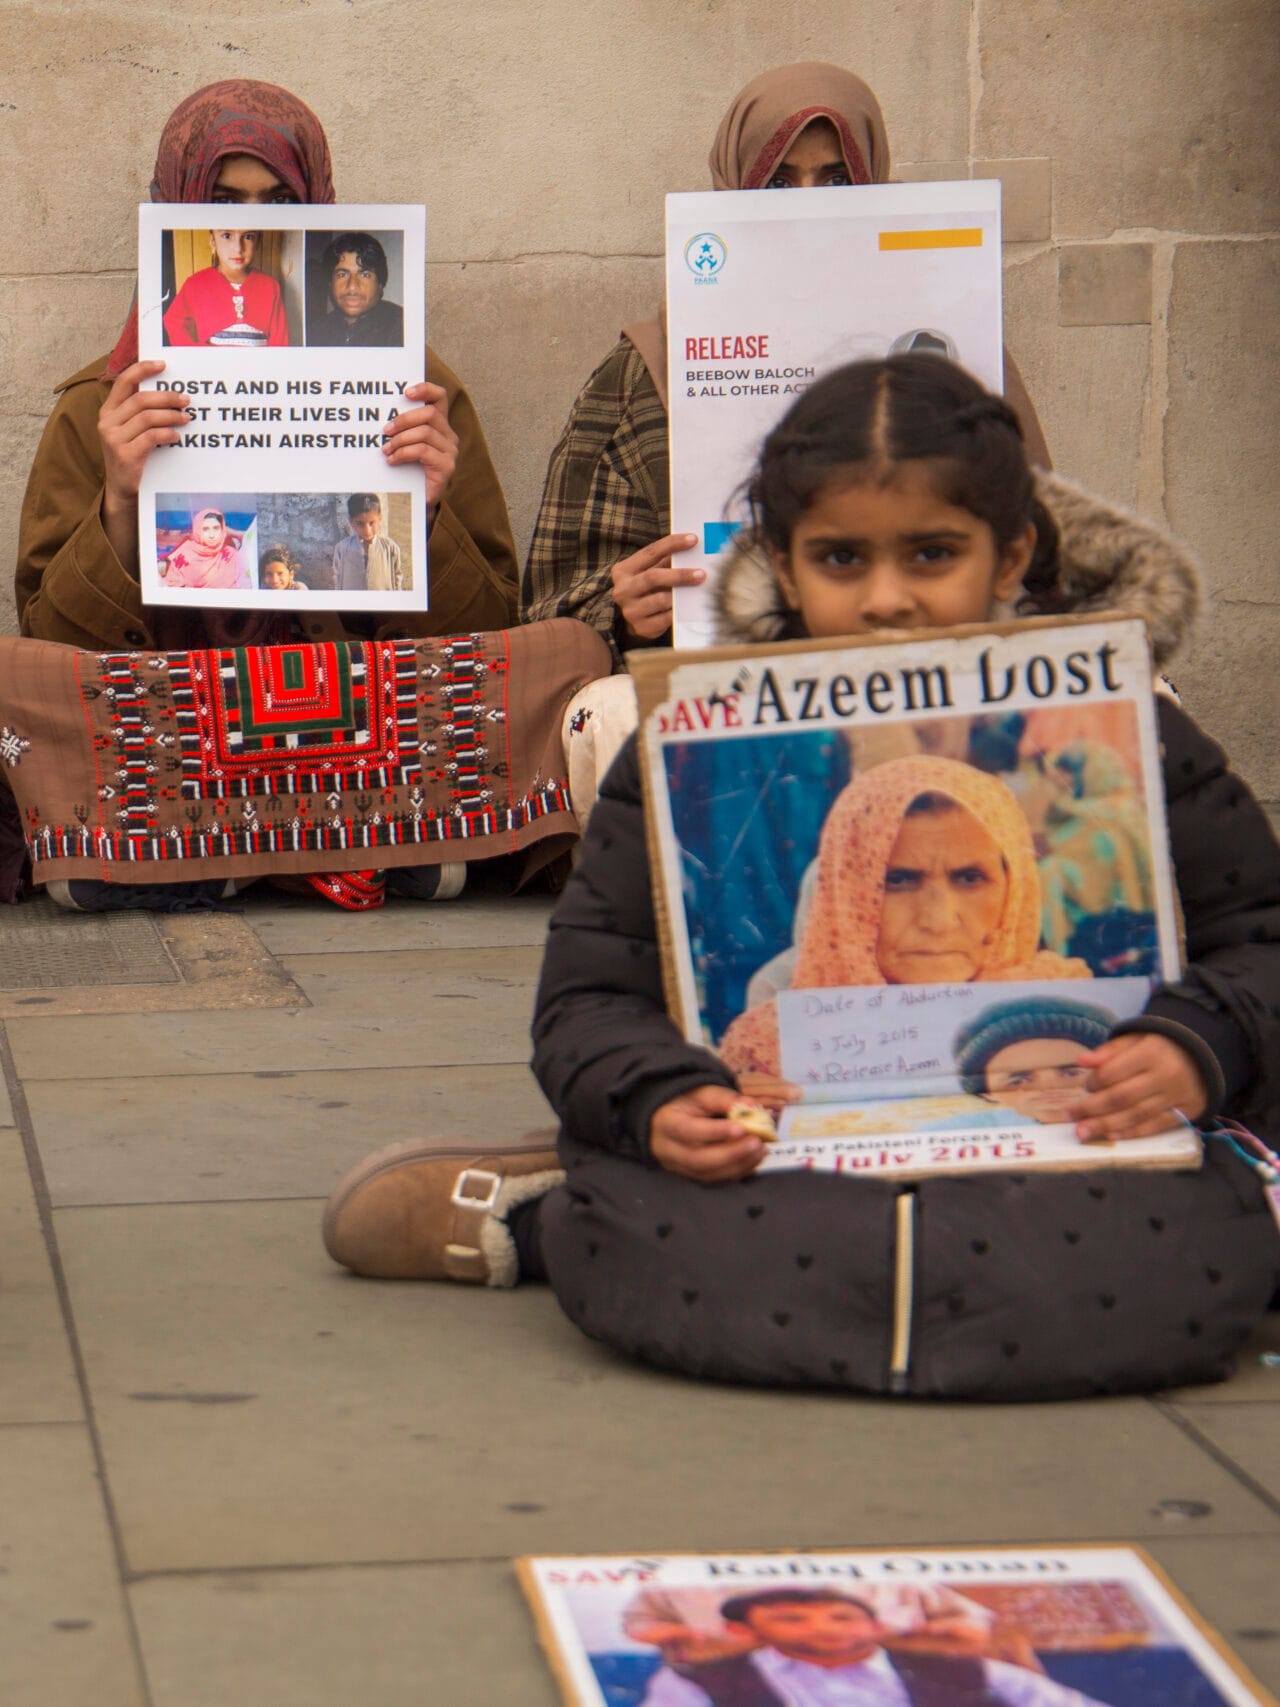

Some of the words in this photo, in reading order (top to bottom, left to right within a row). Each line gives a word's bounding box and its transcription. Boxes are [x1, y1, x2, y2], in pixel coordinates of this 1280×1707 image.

[685, 335, 769, 360] RELEASE
[686, 369, 750, 381] BEEBOW
[755, 367, 815, 380] BALOCH
[156, 381, 227, 394] DOSTA
[235, 381, 279, 394] AND
[287, 381, 322, 394] HIS
[330, 381, 408, 394] FAMILY
[687, 387, 696, 397] &
[700, 386, 727, 396] ALL
[730, 384, 779, 396] OTHER
[218, 407, 282, 421] THEIR
[290, 407, 351, 421] LIVES
[358, 407, 380, 421] IN
[388, 408, 398, 421] A
[753, 662, 955, 725] Azeem
[980, 640, 1123, 704] Lost
[804, 995, 854, 1016] Date
[868, 989, 885, 1008] of
[831, 1033, 866, 1057] July
[878, 1026, 919, 1046] 2015
[825, 1061, 893, 1083] Release
[833, 1137, 921, 1152] Pakistani
[928, 1134, 991, 1146] Forces
[931, 1141, 1036, 1163] 2015
